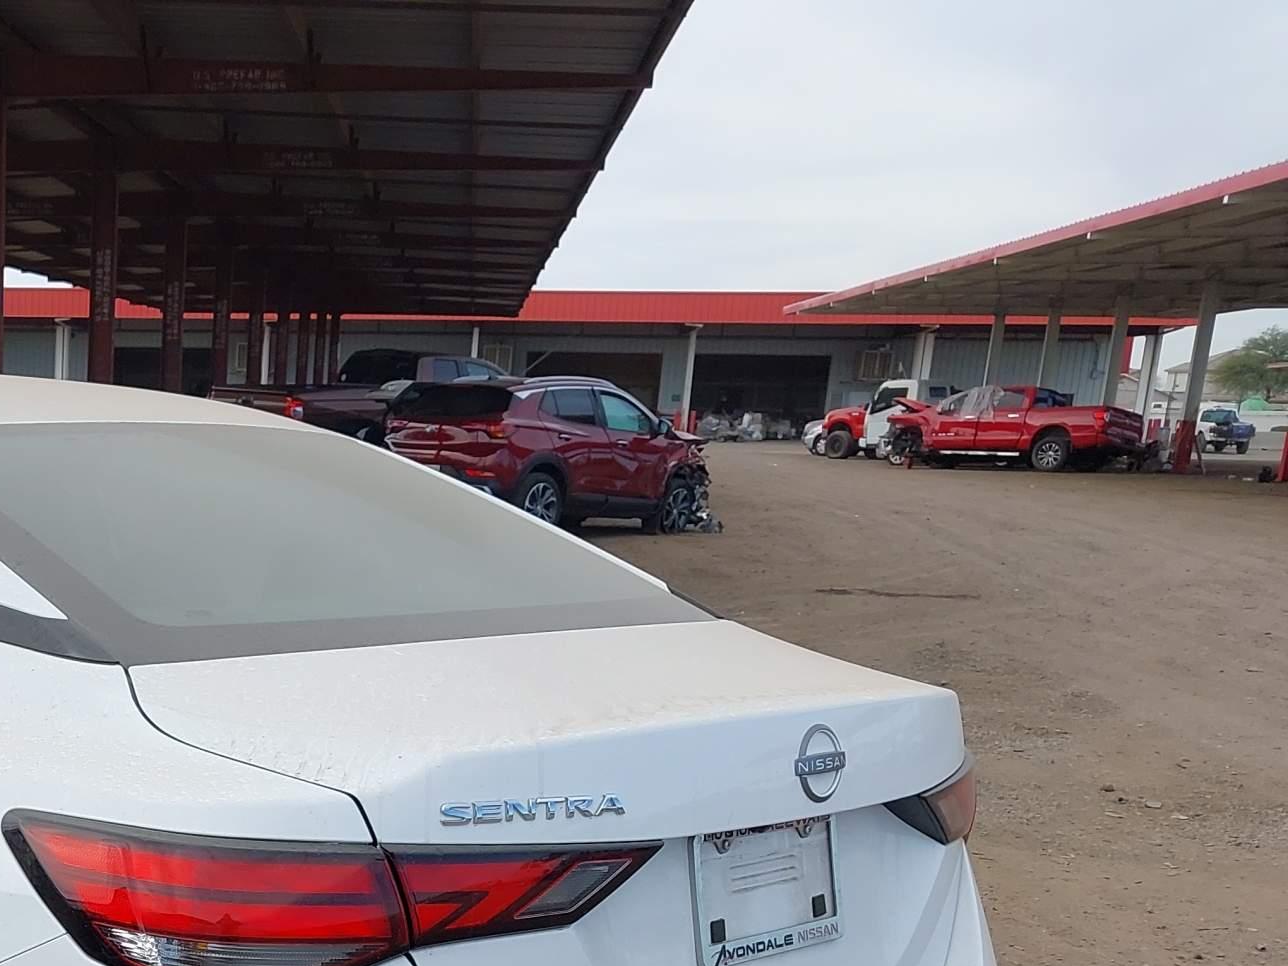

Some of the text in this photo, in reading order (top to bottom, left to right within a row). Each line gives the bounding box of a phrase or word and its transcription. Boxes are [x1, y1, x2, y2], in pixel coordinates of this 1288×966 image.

[797, 755, 845, 774] NISSAN
[439, 792, 626, 827] SENTRA
[797, 921, 840, 944] NISSAN
